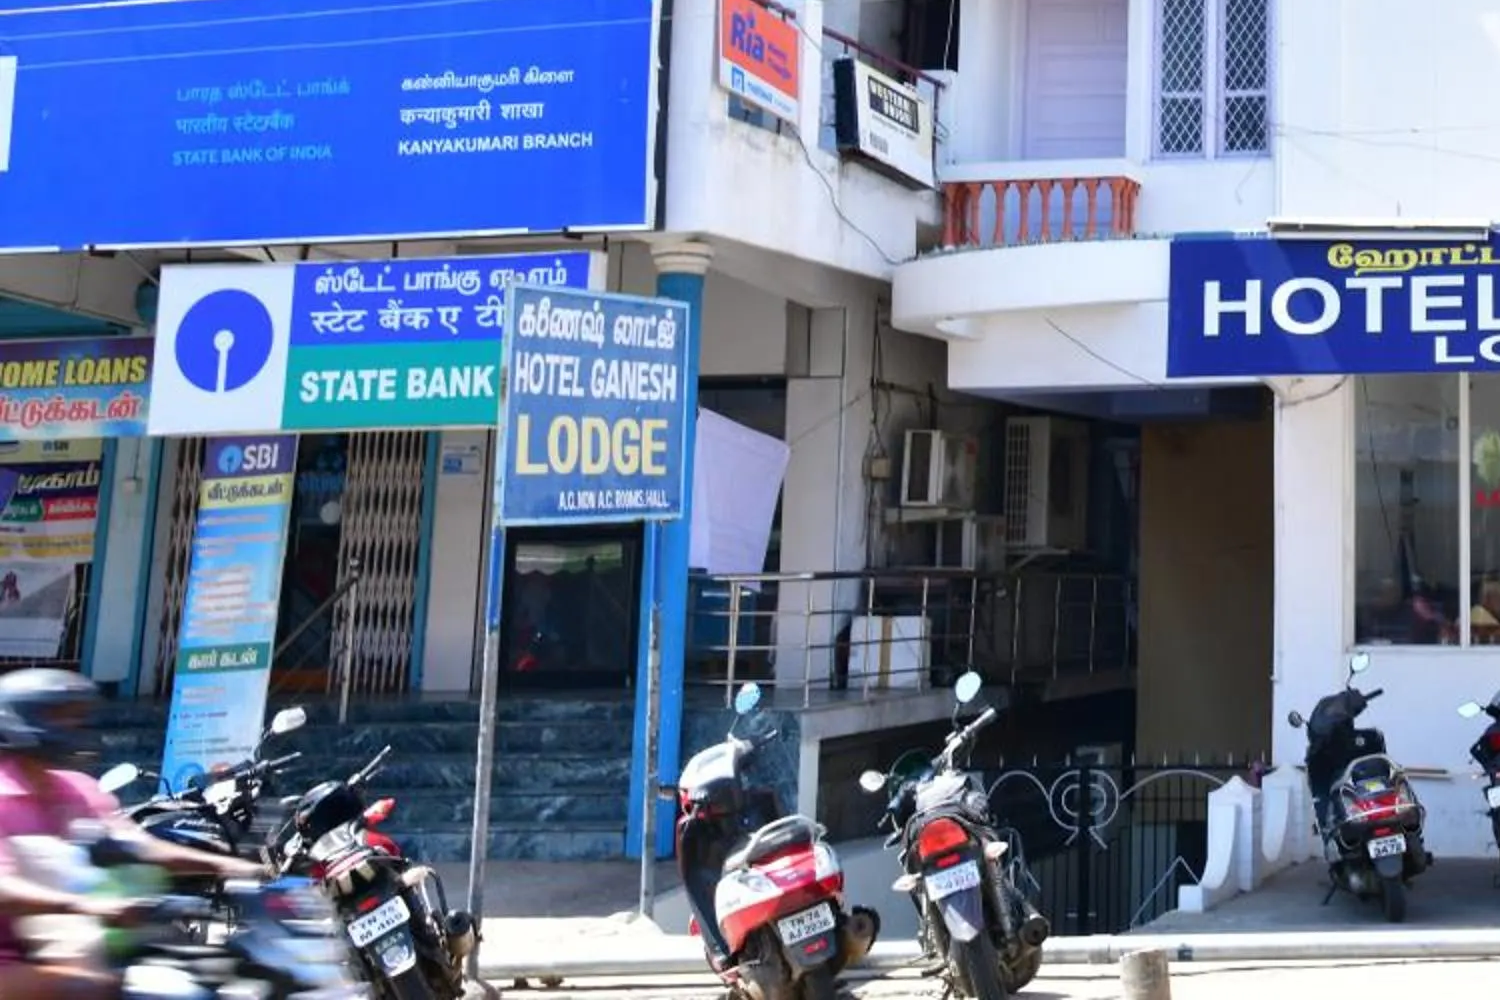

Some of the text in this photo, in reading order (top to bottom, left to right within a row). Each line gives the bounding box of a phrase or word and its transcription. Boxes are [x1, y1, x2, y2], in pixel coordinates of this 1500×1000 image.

[731, 11, 765, 62] Ria
[500, 102, 544, 119] शाखा
[173, 144, 333, 166] STATE BANK OF INDIA
[399, 131, 593, 155] KANYAKUMARI BRANCH
[315, 265, 396, 294] ஸ்டேட்
[404, 263, 480, 295] பாங்கு
[310, 301, 368, 334] स्टेट
[64, 356, 147, 384] LOANS
[300, 365, 495, 403] STATE BANK
[514, 351, 677, 403] HOTEL GANESH
[243, 443, 279, 471] SBI
[515, 413, 668, 476] LODGE
